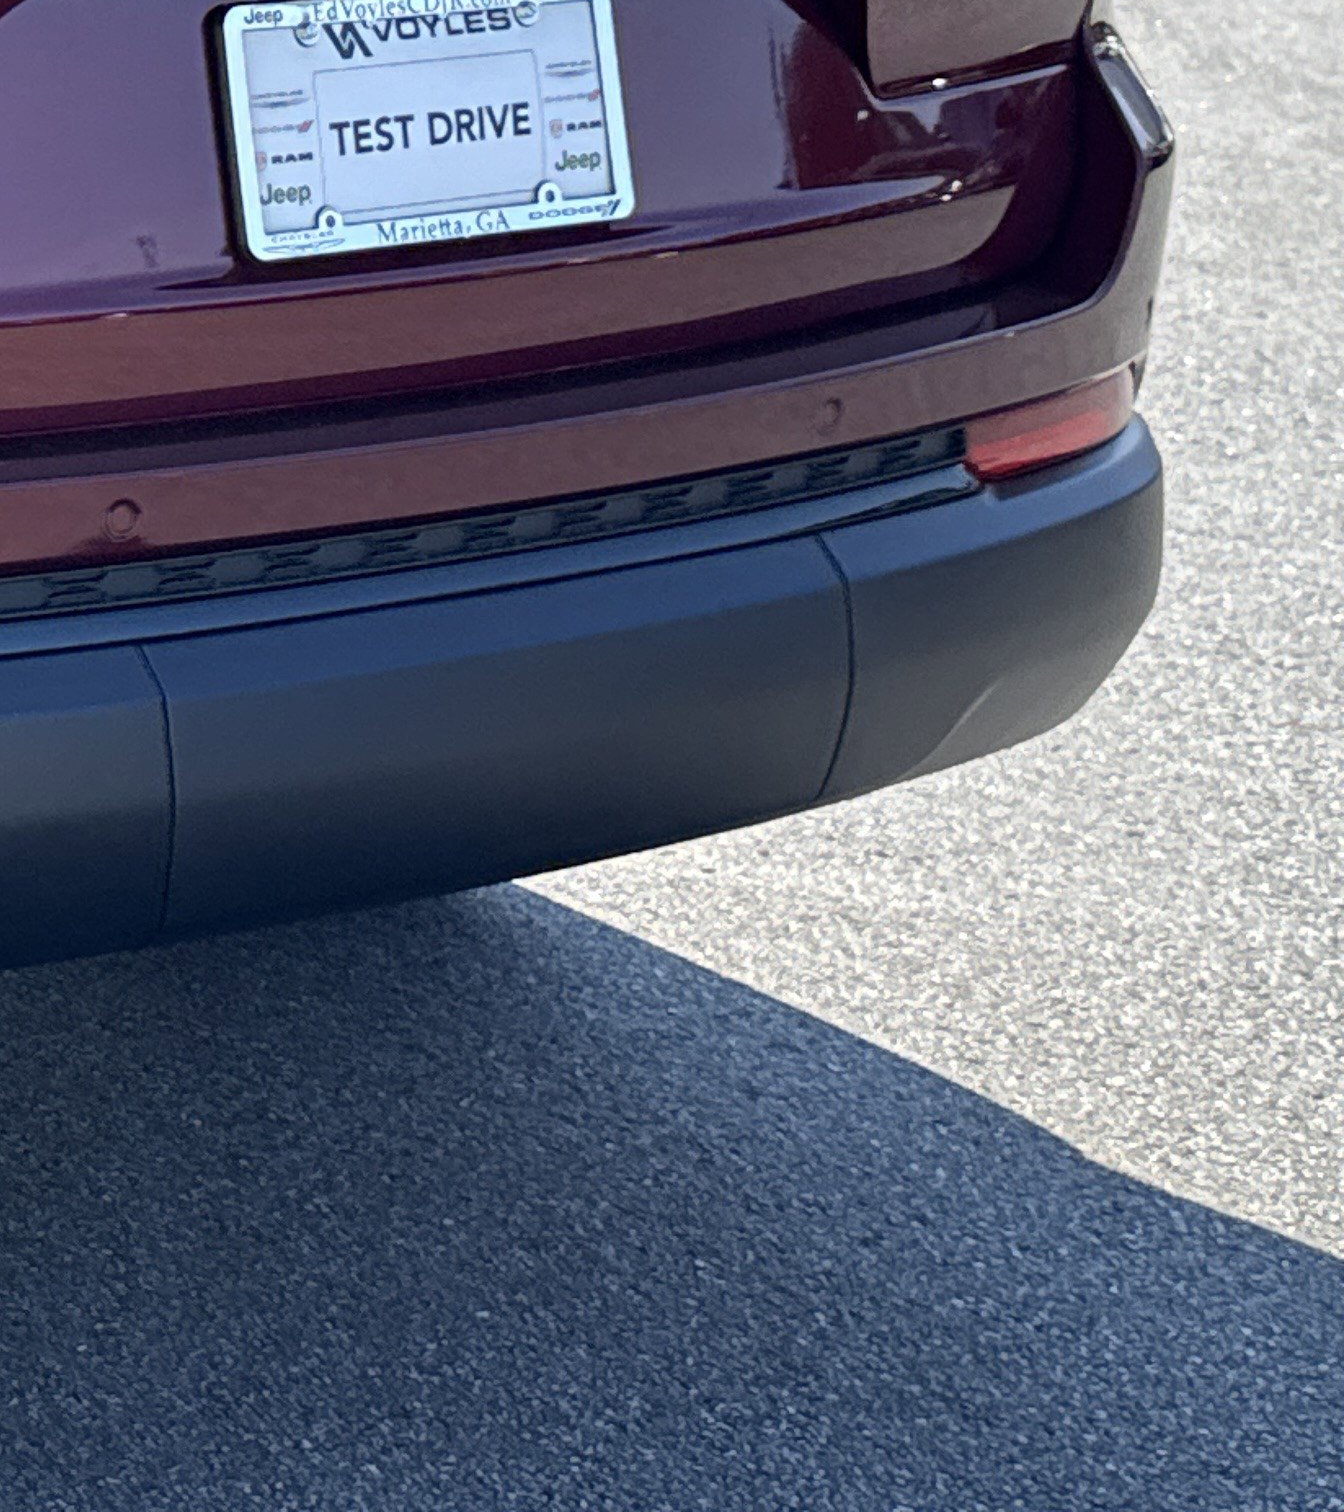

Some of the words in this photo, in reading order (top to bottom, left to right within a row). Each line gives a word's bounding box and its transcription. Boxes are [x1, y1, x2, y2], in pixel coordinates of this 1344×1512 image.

[243, 8, 284, 28] Jeep
[362, 7, 512, 42] VOYLES
[328, 113, 415, 156] TEST
[426, 101, 532, 146] DRIVE
[555, 149, 602, 172] Jeep
[260, 182, 313, 206] Jeep
[475, 208, 511, 233] GA
